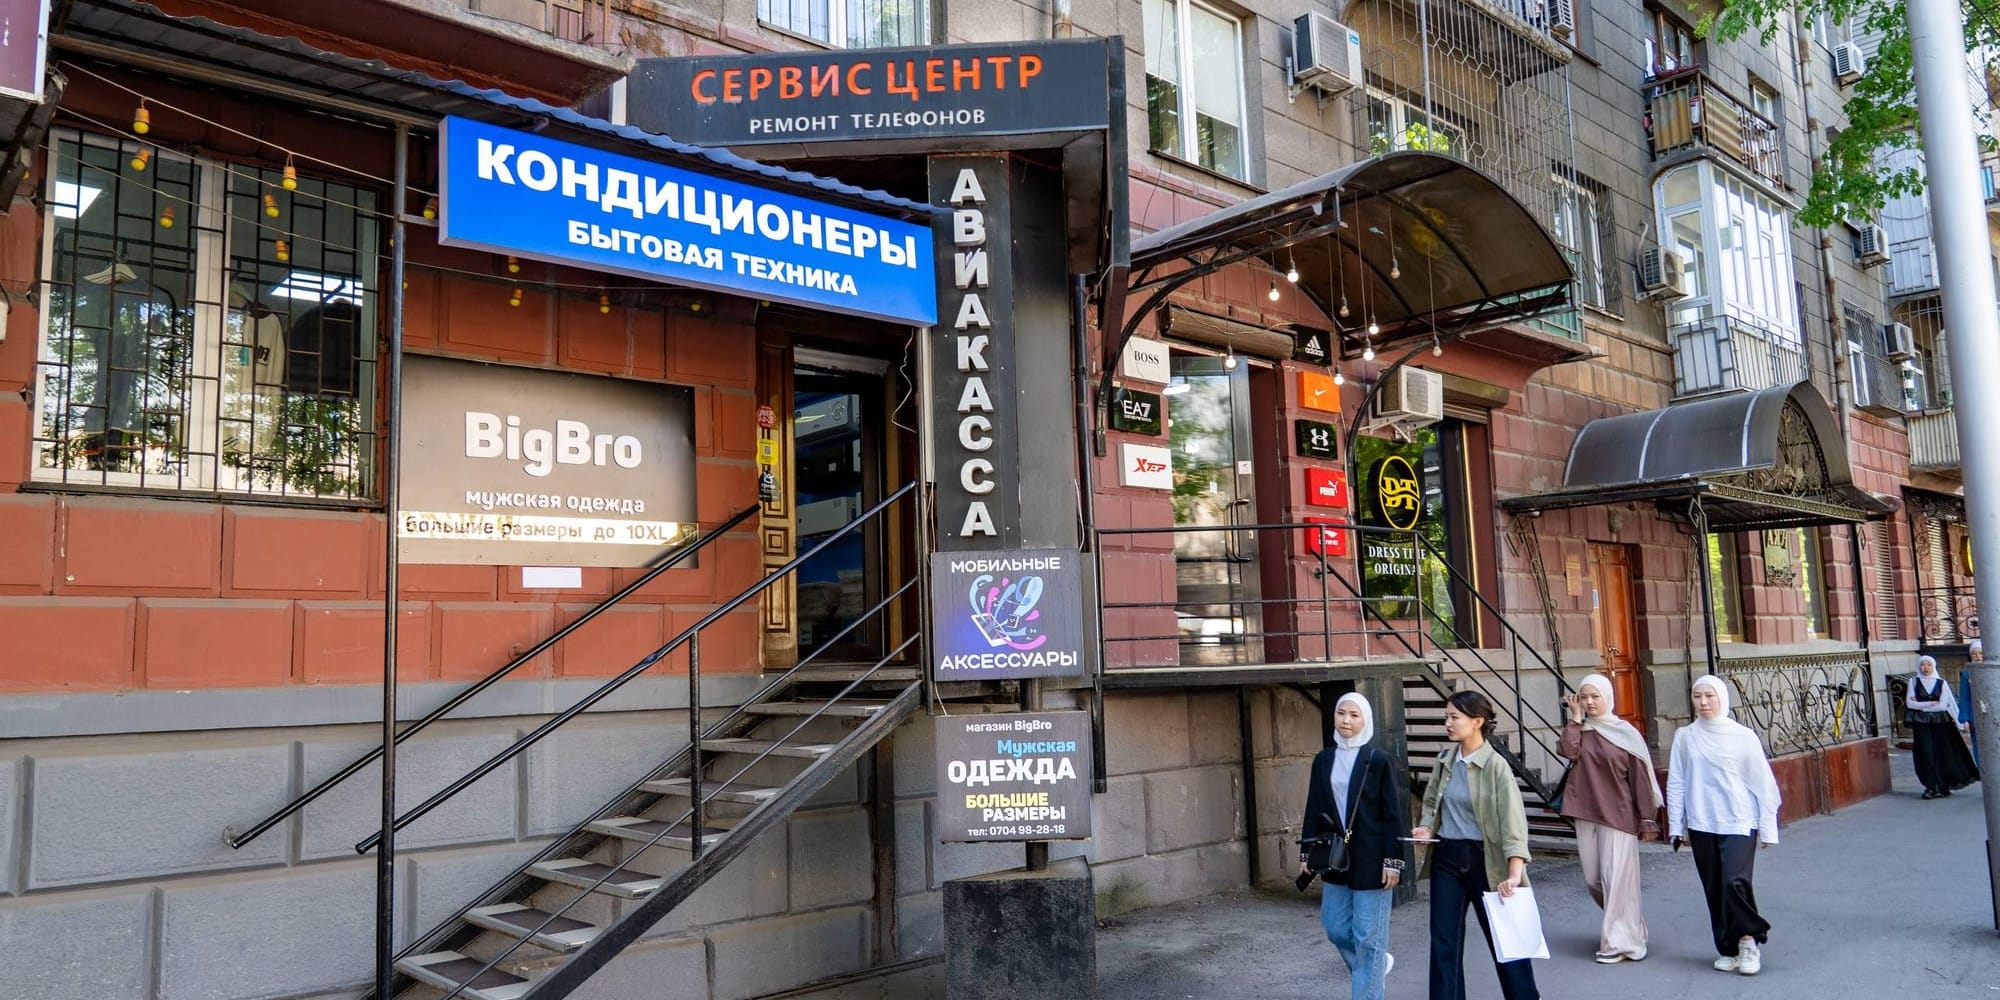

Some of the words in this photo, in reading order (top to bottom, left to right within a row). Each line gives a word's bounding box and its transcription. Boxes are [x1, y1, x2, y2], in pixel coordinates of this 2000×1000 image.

[691, 63, 873, 104] СЕРВИС
[886, 54, 1044, 101] ЦЕНТР
[749, 115, 839, 134] РЕМОНТ
[851, 109, 986, 130] ТЕЛЕФОНОВ
[476, 138, 918, 269] КОНДИЦИОНЕРЫ
[567, 219, 724, 271] БЫТОВАЯ
[731, 252, 859, 296] ТЕХНИКА
[950, 168, 998, 537] АВИАКАССА
[1134, 350, 1160, 365] BOSS
[1123, 399, 1152, 418] EA7
[464, 411, 643, 477] BigBro
[465, 490, 562, 511] мужская
[566, 496, 646, 516] одежда
[405, 515, 495, 535] большие
[501, 522, 583, 540] размеры
[593, 524, 616, 540] до
[625, 523, 668, 541] 10XL
[1368, 545, 1400, 559] DRESS
[1402, 548, 1427, 560] TIE
[951, 556, 1062, 574] МОБИЛЬНЫЕ
[939, 650, 1079, 671] АКСЕССУАРЫ
[966, 723, 1012, 732] магазин
[1014, 720, 1052, 732] BigBro
[997, 739, 1077, 757] Мужская
[948, 757, 1076, 786] ОДЕЖДА
[965, 792, 1049, 809] БОЛЬШИЕ
[983, 806, 1066, 822] РАЗМЕРЫ
[967, 827, 988, 837] тел:
[989, 825, 1017, 836] 0704
[1018, 824, 1066, 835] 98-28-18
